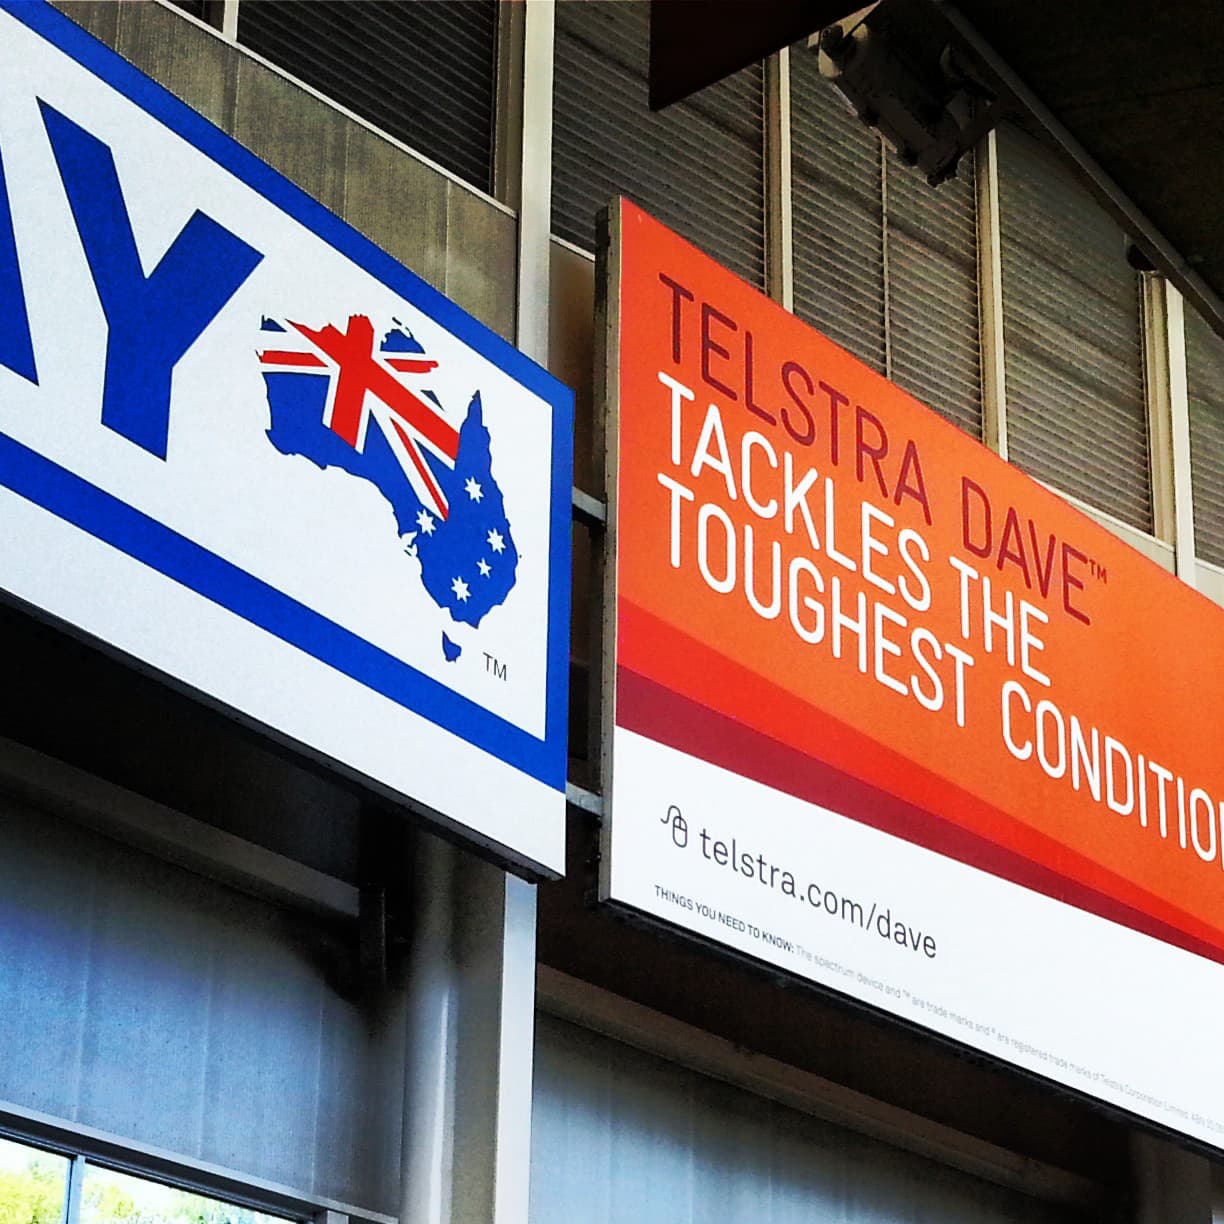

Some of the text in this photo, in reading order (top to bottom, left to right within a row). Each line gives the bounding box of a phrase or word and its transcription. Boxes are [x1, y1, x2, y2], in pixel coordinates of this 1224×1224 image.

[0, 95, 265, 462] Y
[658, 271, 932, 527] TELSTRA
[656, 472, 975, 728] TOUGHEST
[657, 370, 1052, 688] TACKLES THE
[654, 884, 694, 911] THINGS
[695, 901, 717, 920] YOU
[718, 911, 746, 933] NEED
[747, 923, 760, 939] TO
[761, 931, 795, 954] KNOW:
[796, 944, 812, 961] The
[885, 984, 902, 999] and
[699, 828, 938, 960] telstra.com/dave
